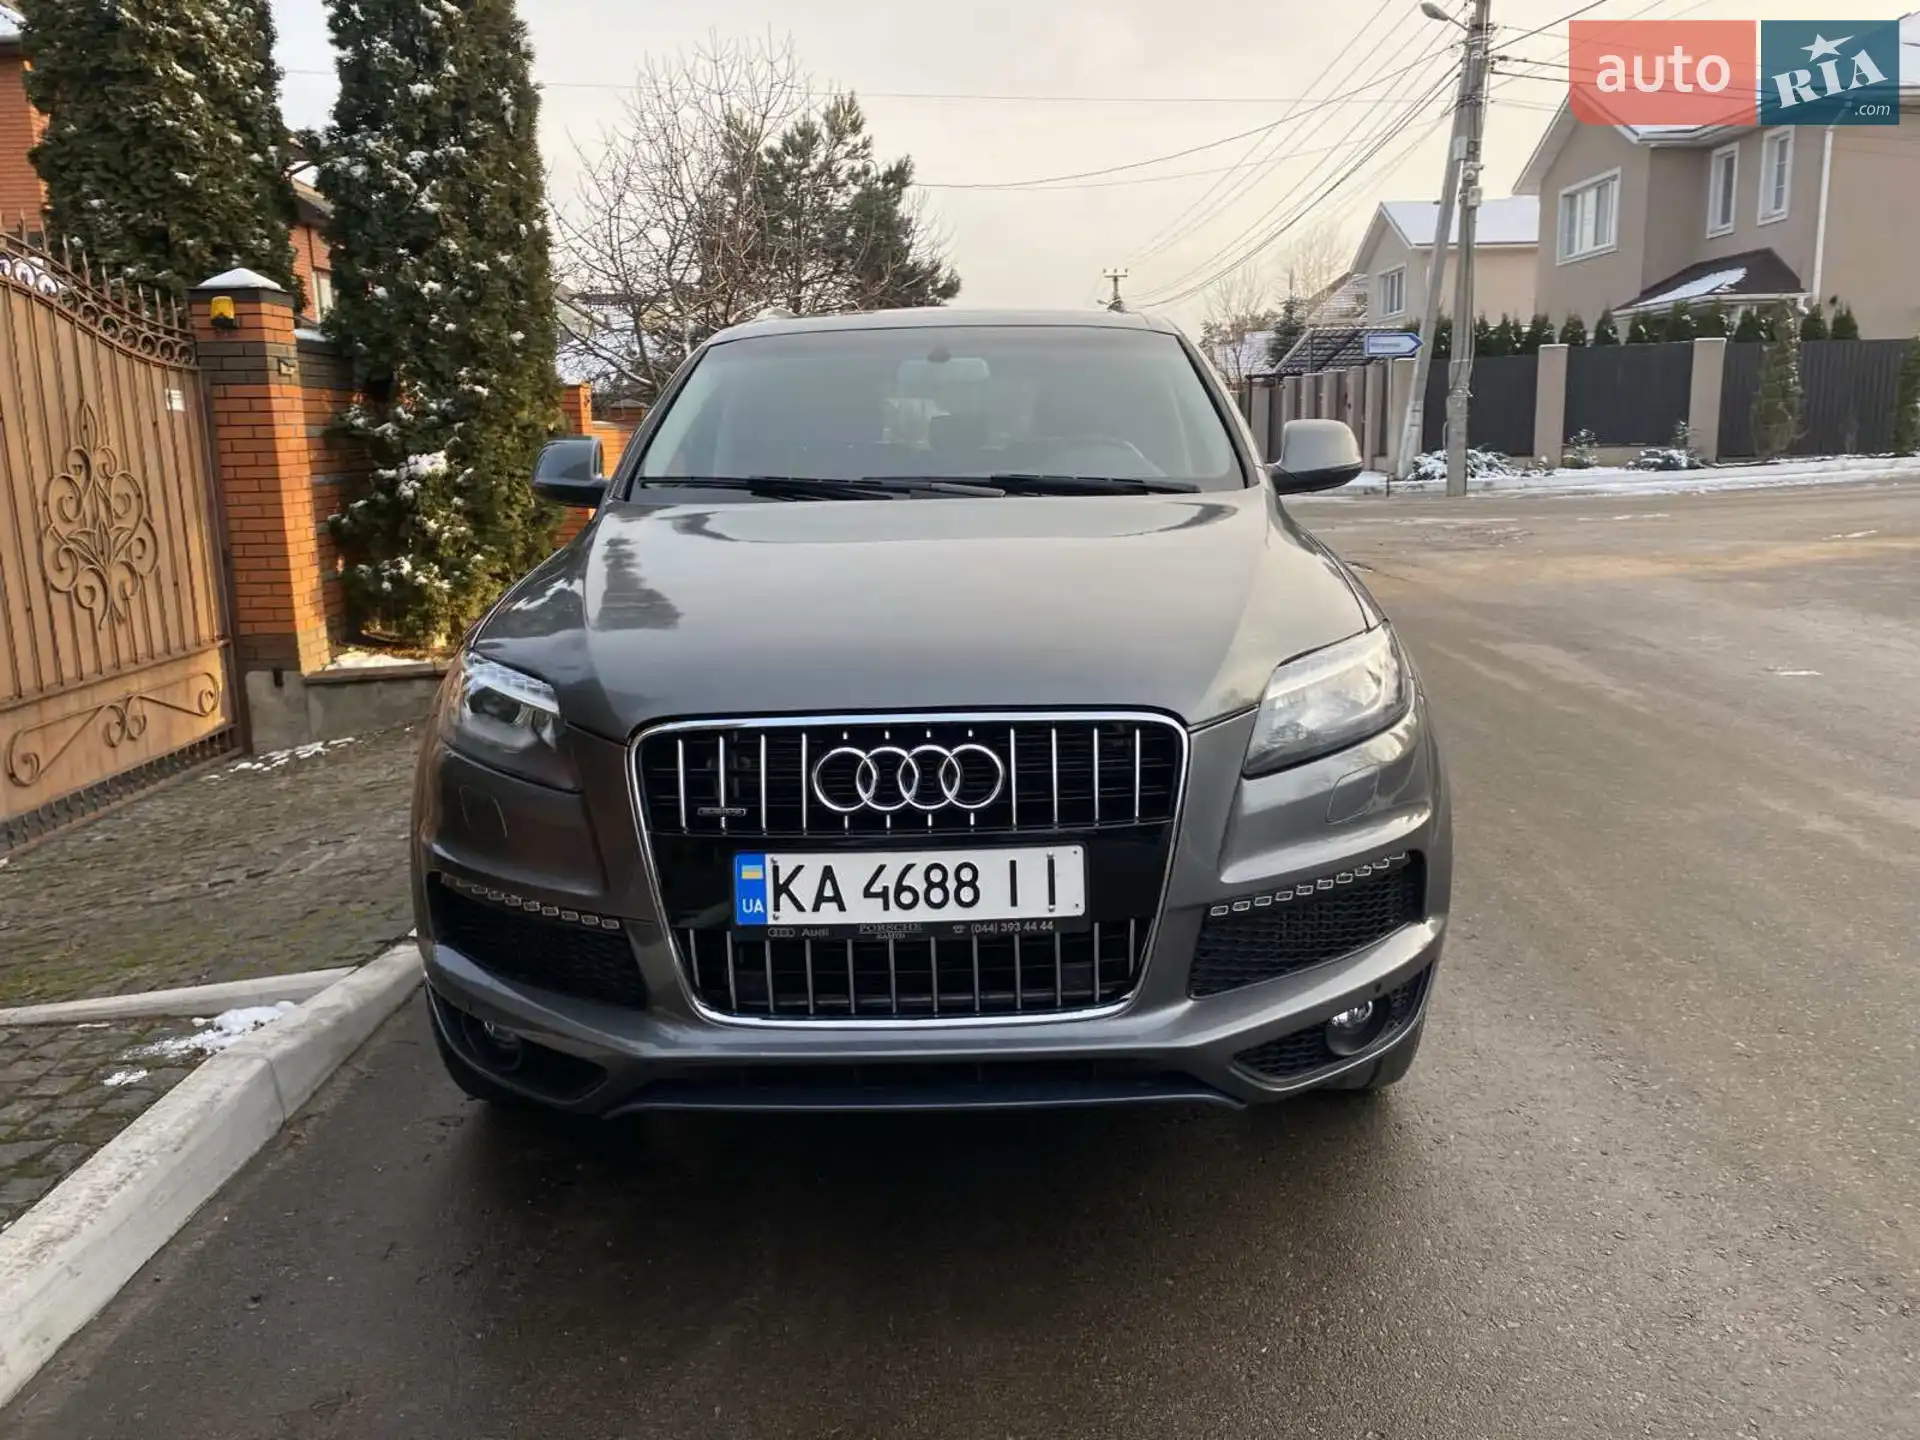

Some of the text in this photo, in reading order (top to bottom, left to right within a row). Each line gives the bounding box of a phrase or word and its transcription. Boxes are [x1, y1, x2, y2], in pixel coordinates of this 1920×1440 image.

[772, 864, 847, 912] KA
[863, 861, 980, 911] 4688
[742, 898, 764, 913] UA
[801, 927, 830, 938] Audi
[970, 920, 1054, 935] (044) 393 44 44
